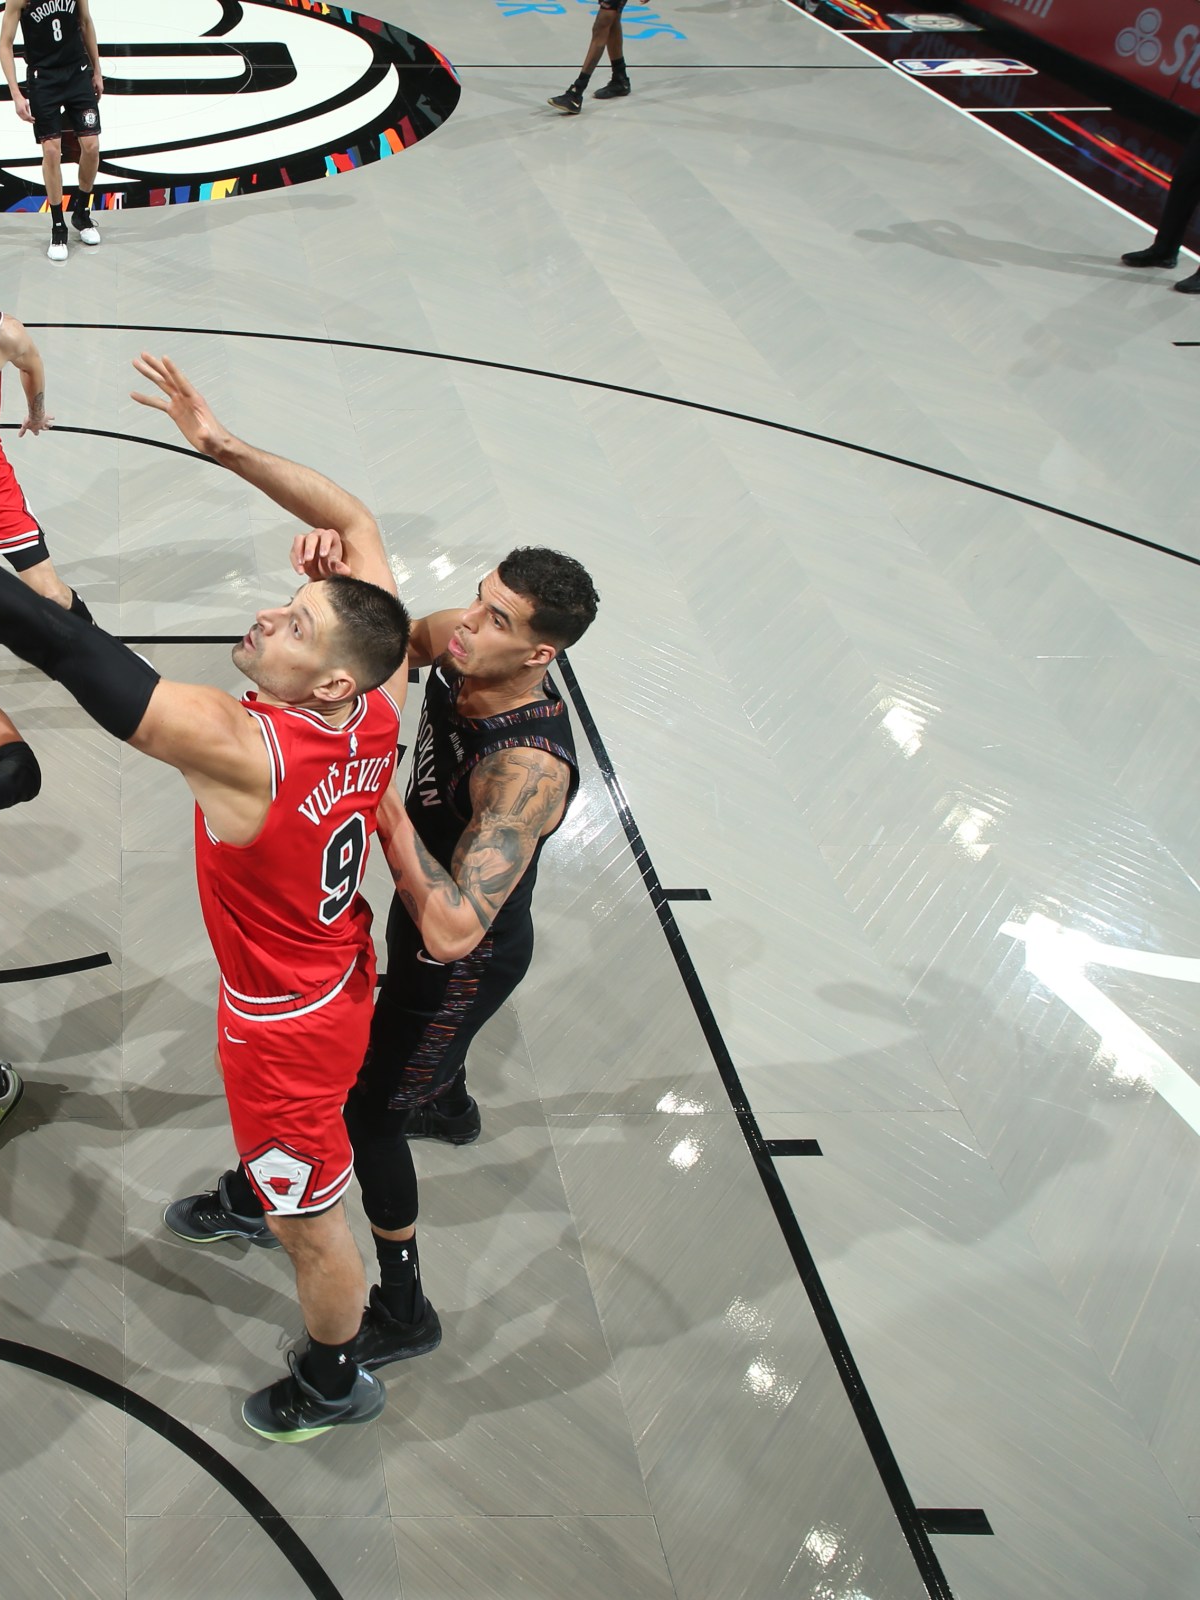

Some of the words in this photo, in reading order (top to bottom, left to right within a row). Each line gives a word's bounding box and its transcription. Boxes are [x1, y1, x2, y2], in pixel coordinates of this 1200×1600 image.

[30, 0, 76, 23] BROOKLYN
[51, 18, 62, 42] 8
[297, 751, 393, 826] VUČEVIĆ
[318, 811, 367, 926] 9
